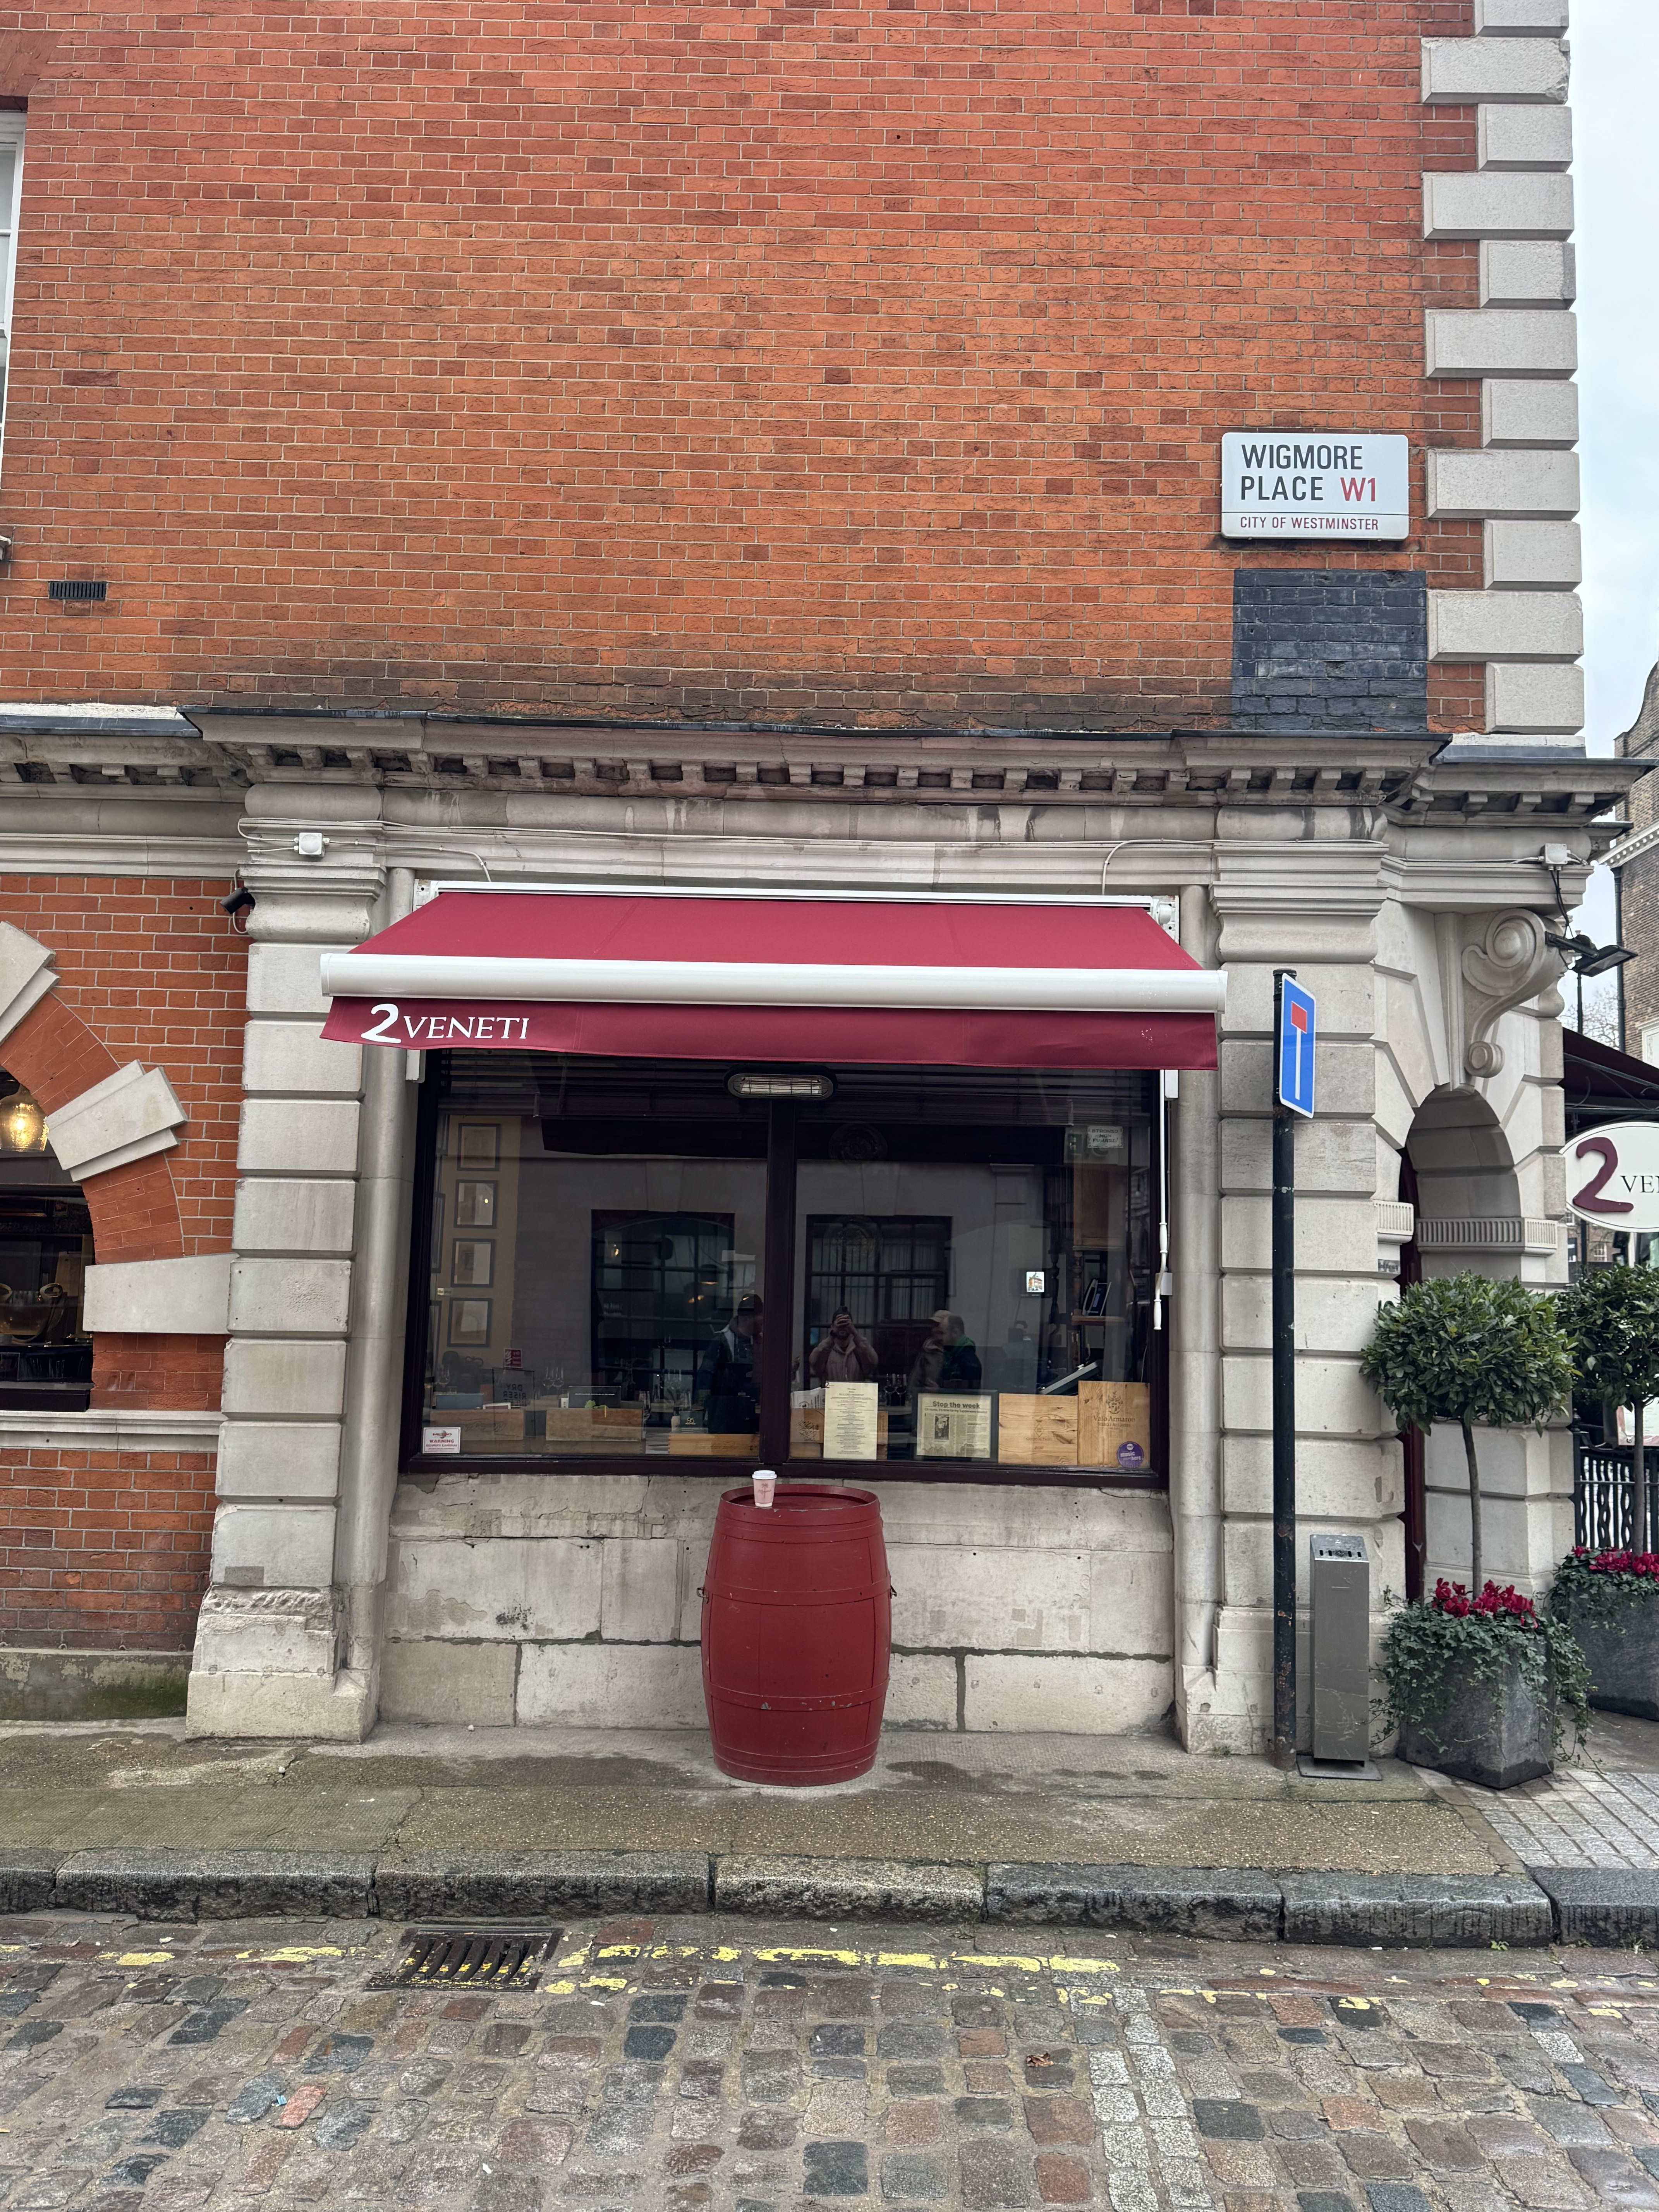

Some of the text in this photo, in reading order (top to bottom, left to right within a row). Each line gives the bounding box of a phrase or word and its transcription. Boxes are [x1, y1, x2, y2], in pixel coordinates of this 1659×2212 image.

[1241, 444, 1363, 470] WIGMORE
[1241, 476, 1376, 501] PLACE W1
[1240, 517, 1378, 530] CITY OF WESTMINSTER
[361, 1003, 530, 1044] 2 VENETI
[1572, 1137, 1659, 1212] 2 VE
